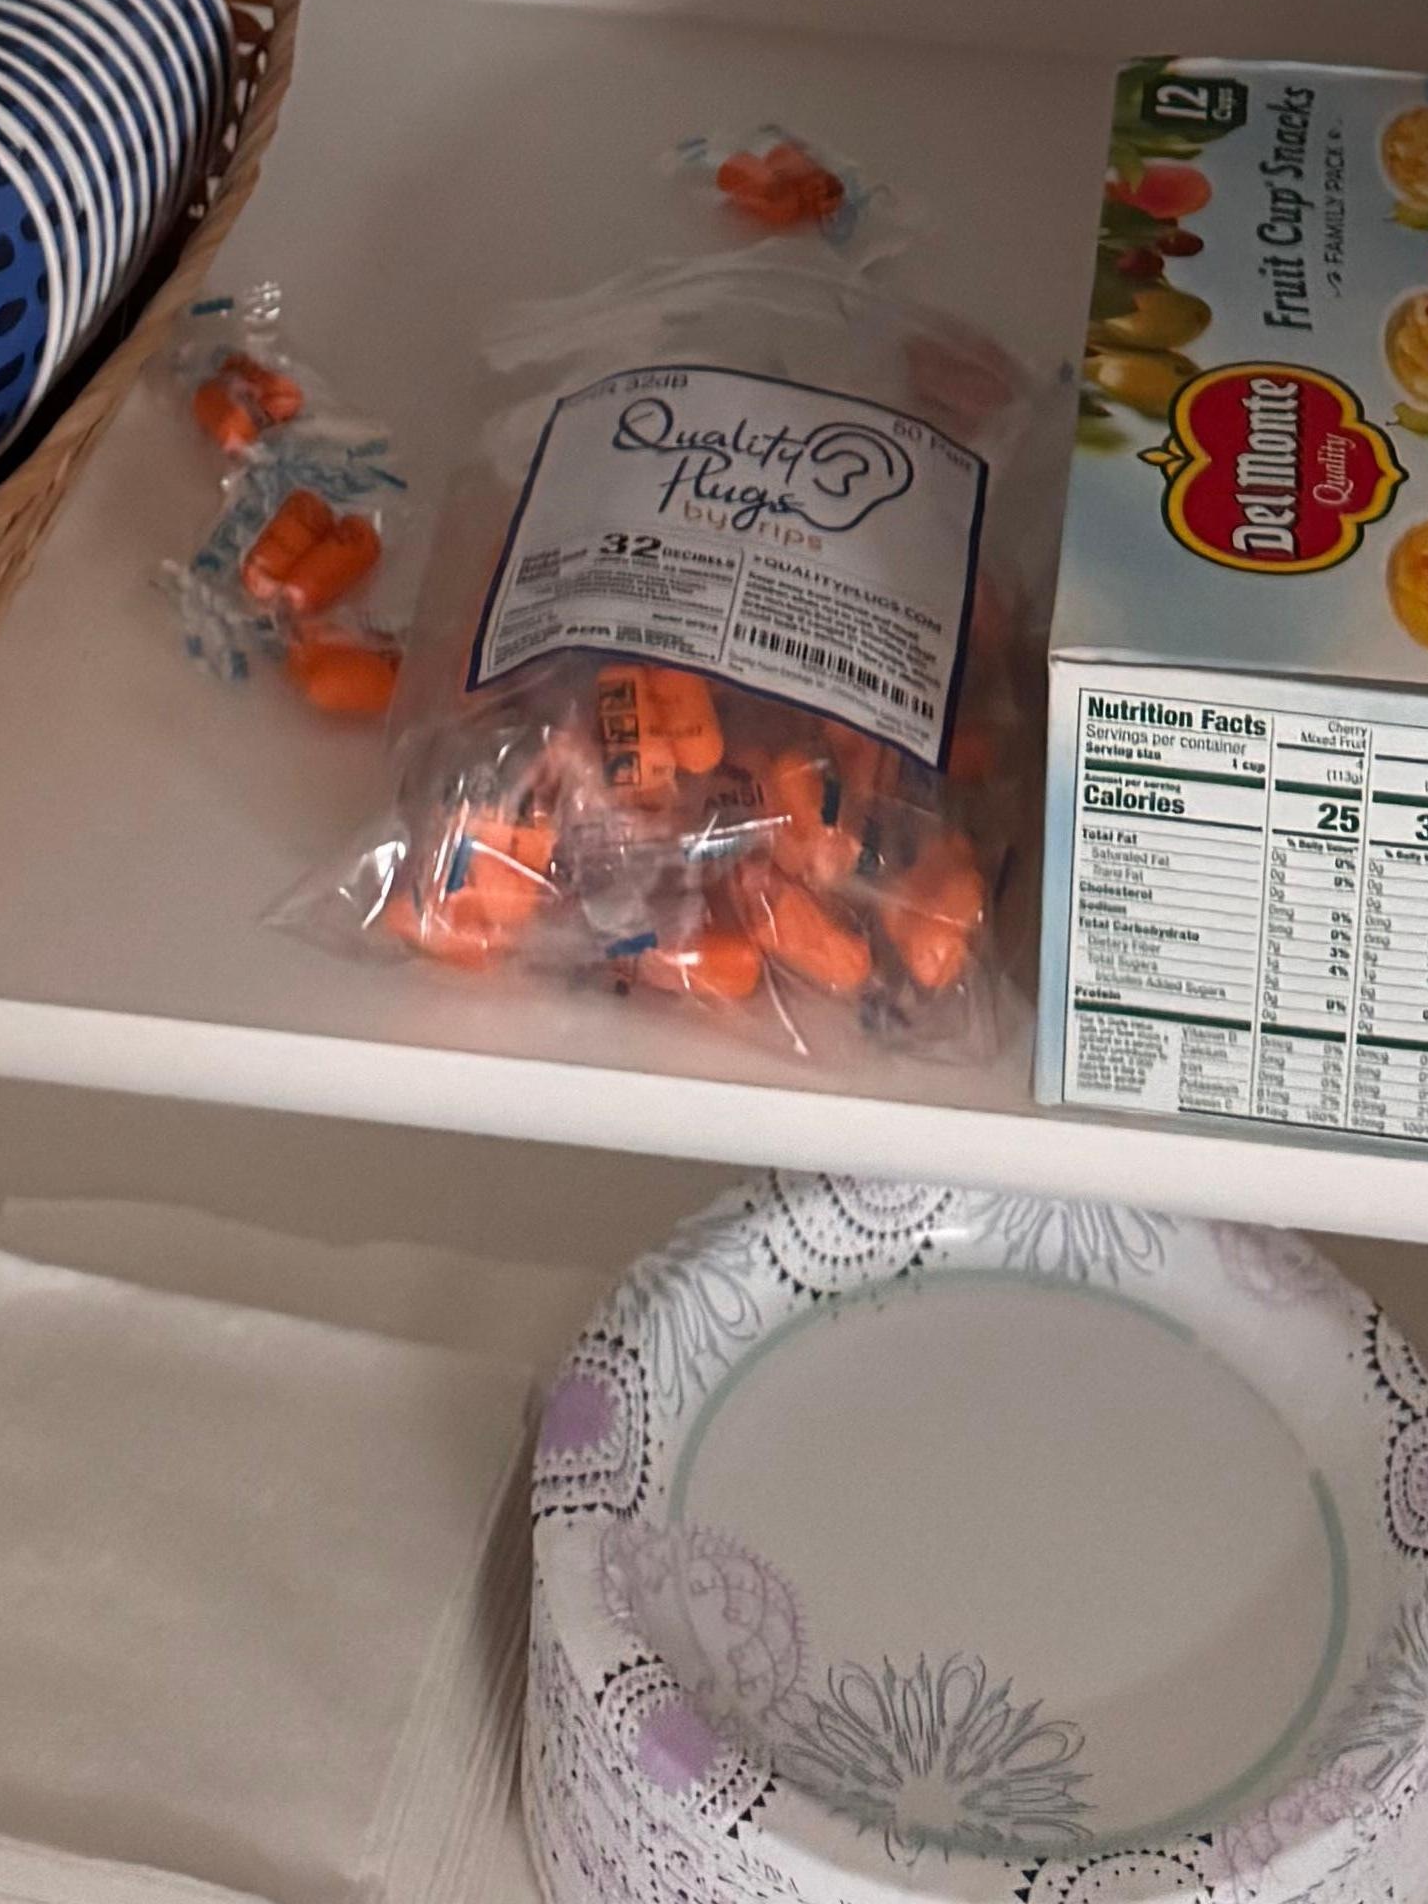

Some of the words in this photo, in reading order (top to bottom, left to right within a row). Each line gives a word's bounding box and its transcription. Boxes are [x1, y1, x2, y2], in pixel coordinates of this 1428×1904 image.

[1155, 85, 1208, 120] 12
[1259, 86, 1315, 180] Snacks
[1324, 145, 1345, 193] PACK
[1257, 188, 1314, 246] Cup
[1324, 195, 1345, 264] FAMILY
[1258, 255, 1312, 331] Fruit
[612, 397, 809, 485] Quality
[1233, 377, 1300, 490] Monte
[1312, 433, 1356, 506] Quality
[1231, 493, 1299, 558] Del
[600, 533, 662, 558] 32
[1087, 696, 1193, 728] Nutrition
[1201, 710, 1267, 736] Facts
[1328, 721, 1369, 738] Cherry
[1086, 724, 1148, 746] Servings
[1152, 733, 1174, 747] per
[1180, 736, 1247, 755] container
[1086, 742, 1133, 760] Serving
[1136, 747, 1162, 761] size
[1301, 732, 1336, 745] Mixed
[1339, 736, 1367, 750] Fruit
[1242, 762, 1266, 774] cup
[1083, 784, 1185, 814] Calories
[1082, 827, 1114, 842] Total
[1117, 831, 1138, 844] Fat
[1317, 802, 1361, 834] 25
[1079, 881, 1153, 901] Cholesterol
